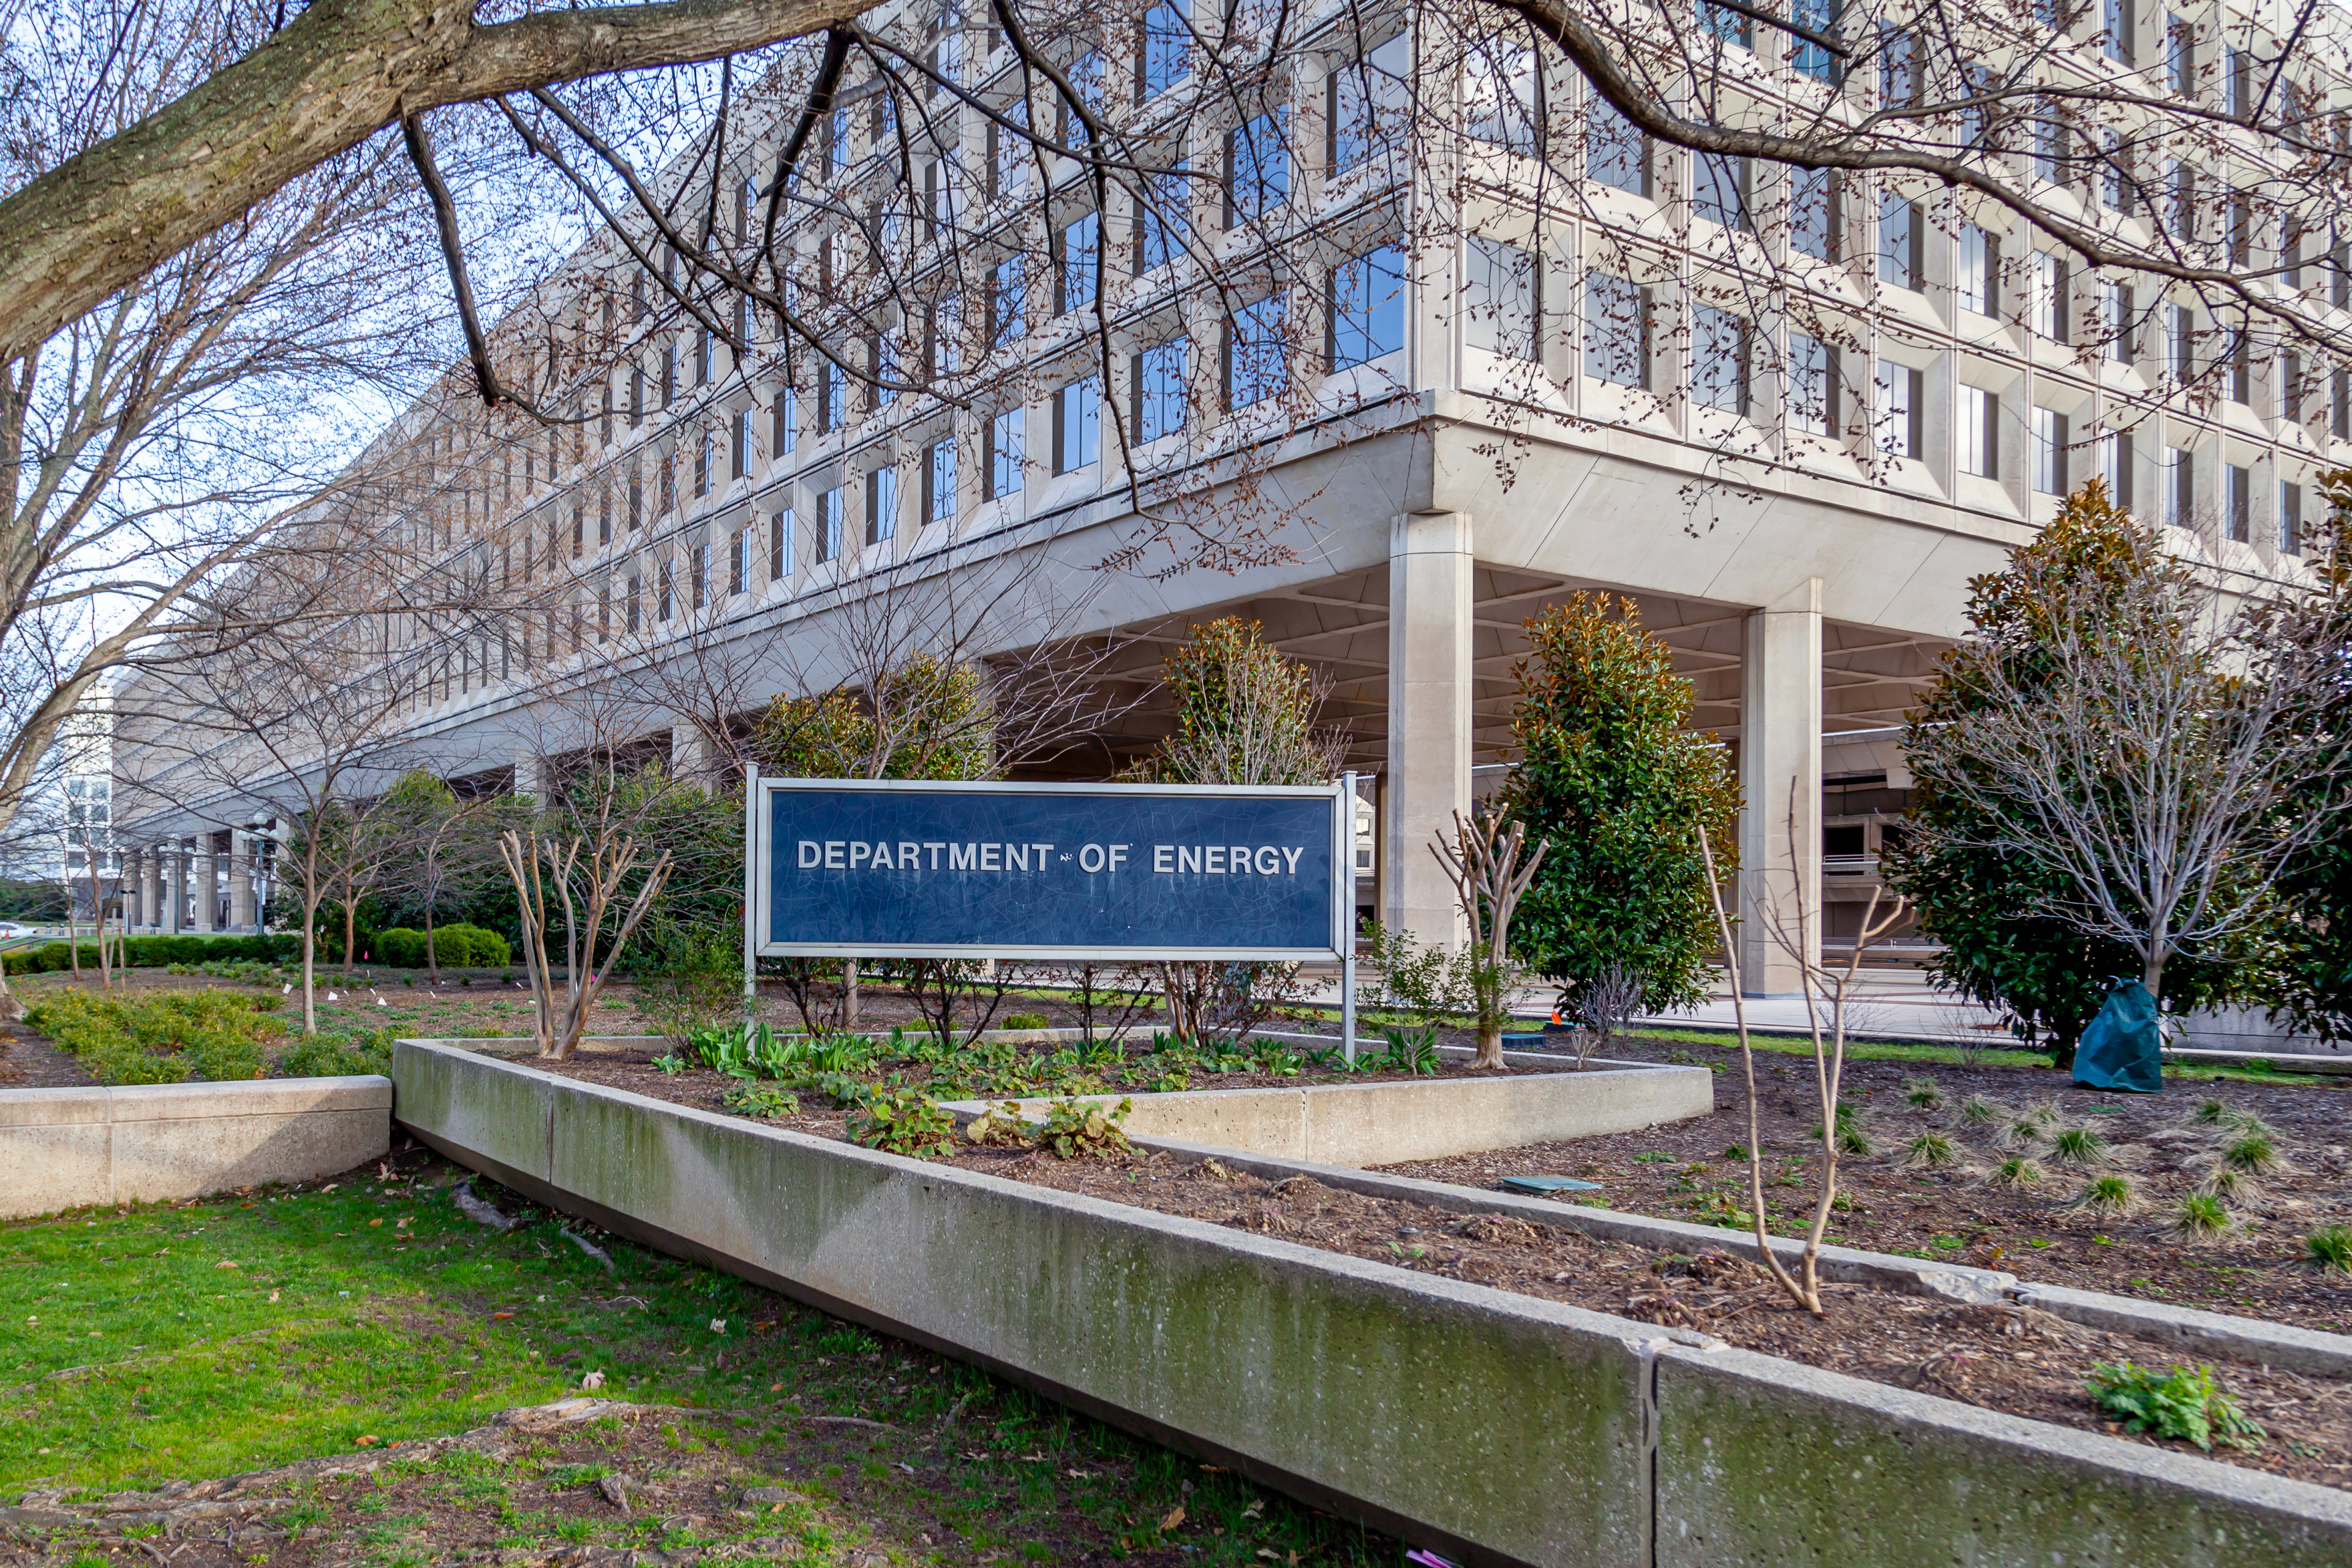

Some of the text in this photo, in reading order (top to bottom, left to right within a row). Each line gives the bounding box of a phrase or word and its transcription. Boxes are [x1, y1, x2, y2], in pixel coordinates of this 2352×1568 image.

[797, 840, 1305, 875] DEPARTMENT OF ENERGY
